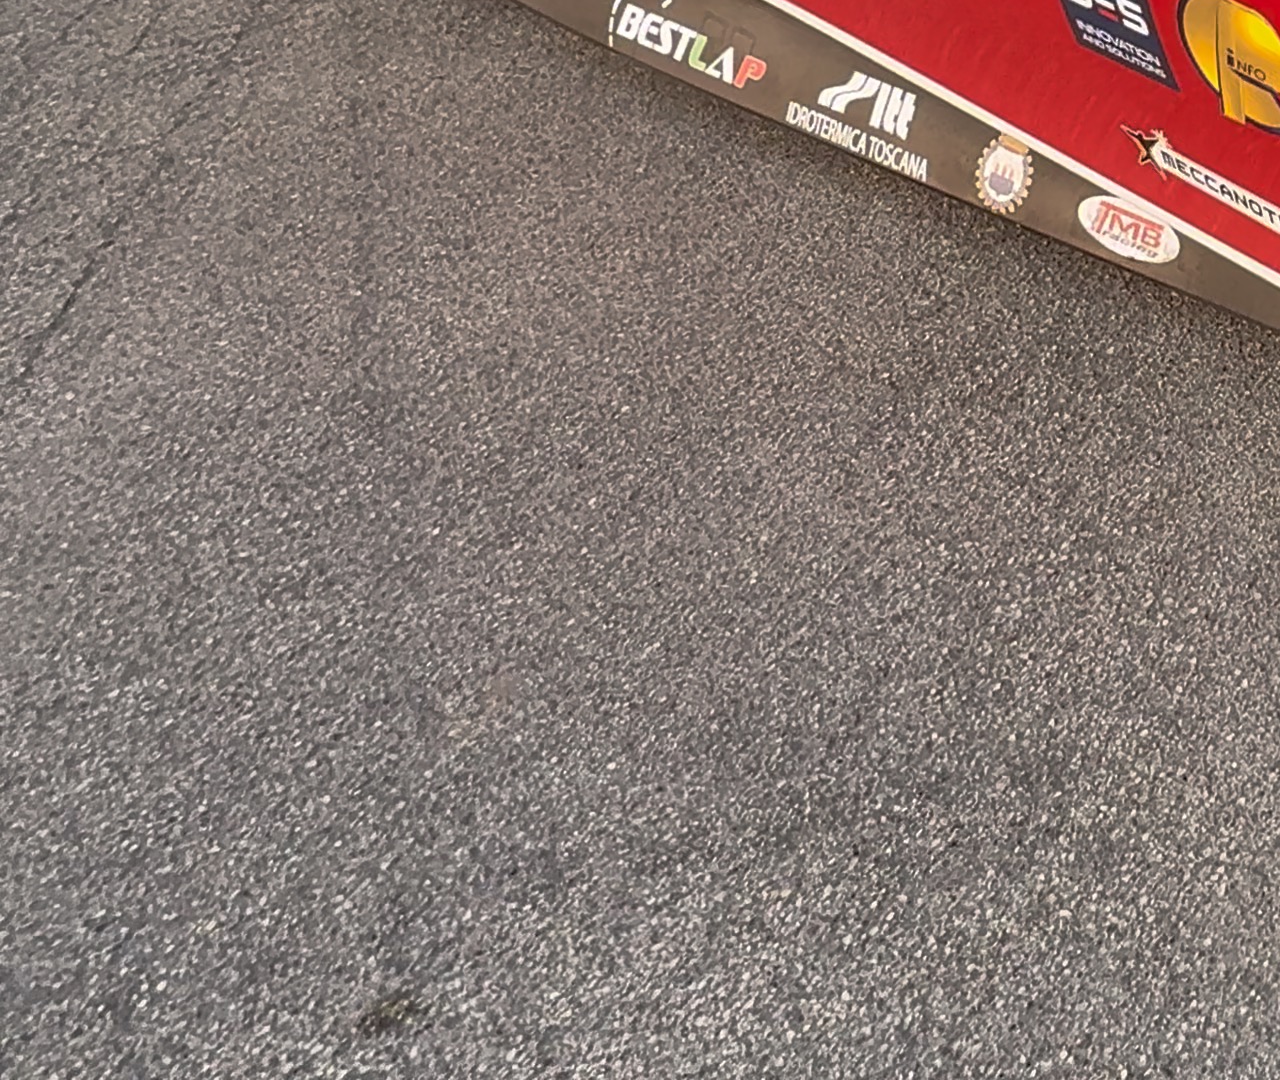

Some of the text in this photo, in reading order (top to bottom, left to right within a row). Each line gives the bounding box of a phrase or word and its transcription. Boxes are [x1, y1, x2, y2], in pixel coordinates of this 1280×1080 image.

[615, 2, 768, 90] BESTLAP
[1076, 19, 1161, 68] INNOVATION
[1105, 43, 1167, 79] SOLUTIONS
[785, 100, 929, 184] IDROTERMICA TOSCANA
